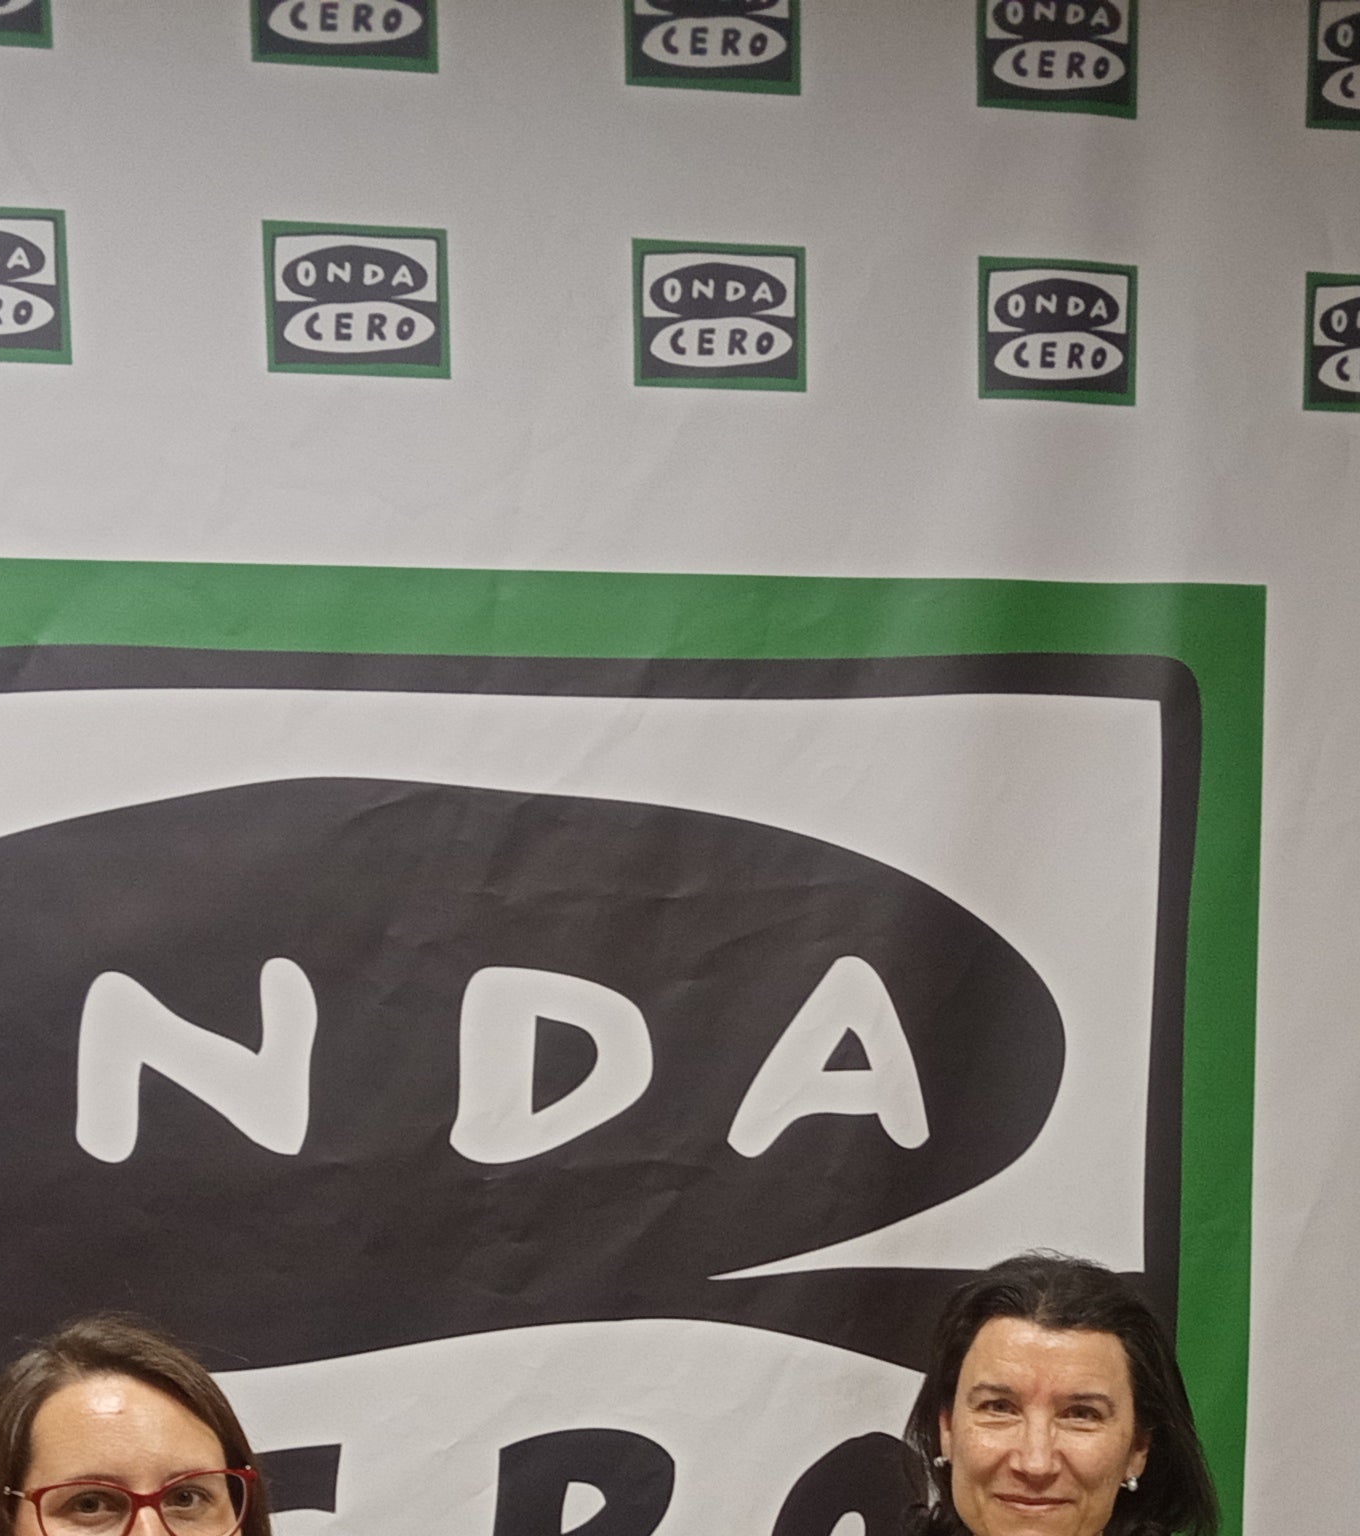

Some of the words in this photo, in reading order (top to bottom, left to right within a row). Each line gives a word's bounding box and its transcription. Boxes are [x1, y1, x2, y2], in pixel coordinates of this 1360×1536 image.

[289, 1, 403, 34] CERO
[1005, 0, 1109, 27] ONDA
[661, 26, 769, 57] CERO
[1012, 50, 1110, 80] CERO
[296, 260, 414, 287] ONDA
[663, 277, 773, 303] ONDA
[1007, 293, 1108, 319] ONDA
[304, 312, 416, 342] CERO
[669, 327, 775, 356] CERO
[1013, 341, 1108, 371] CERO
